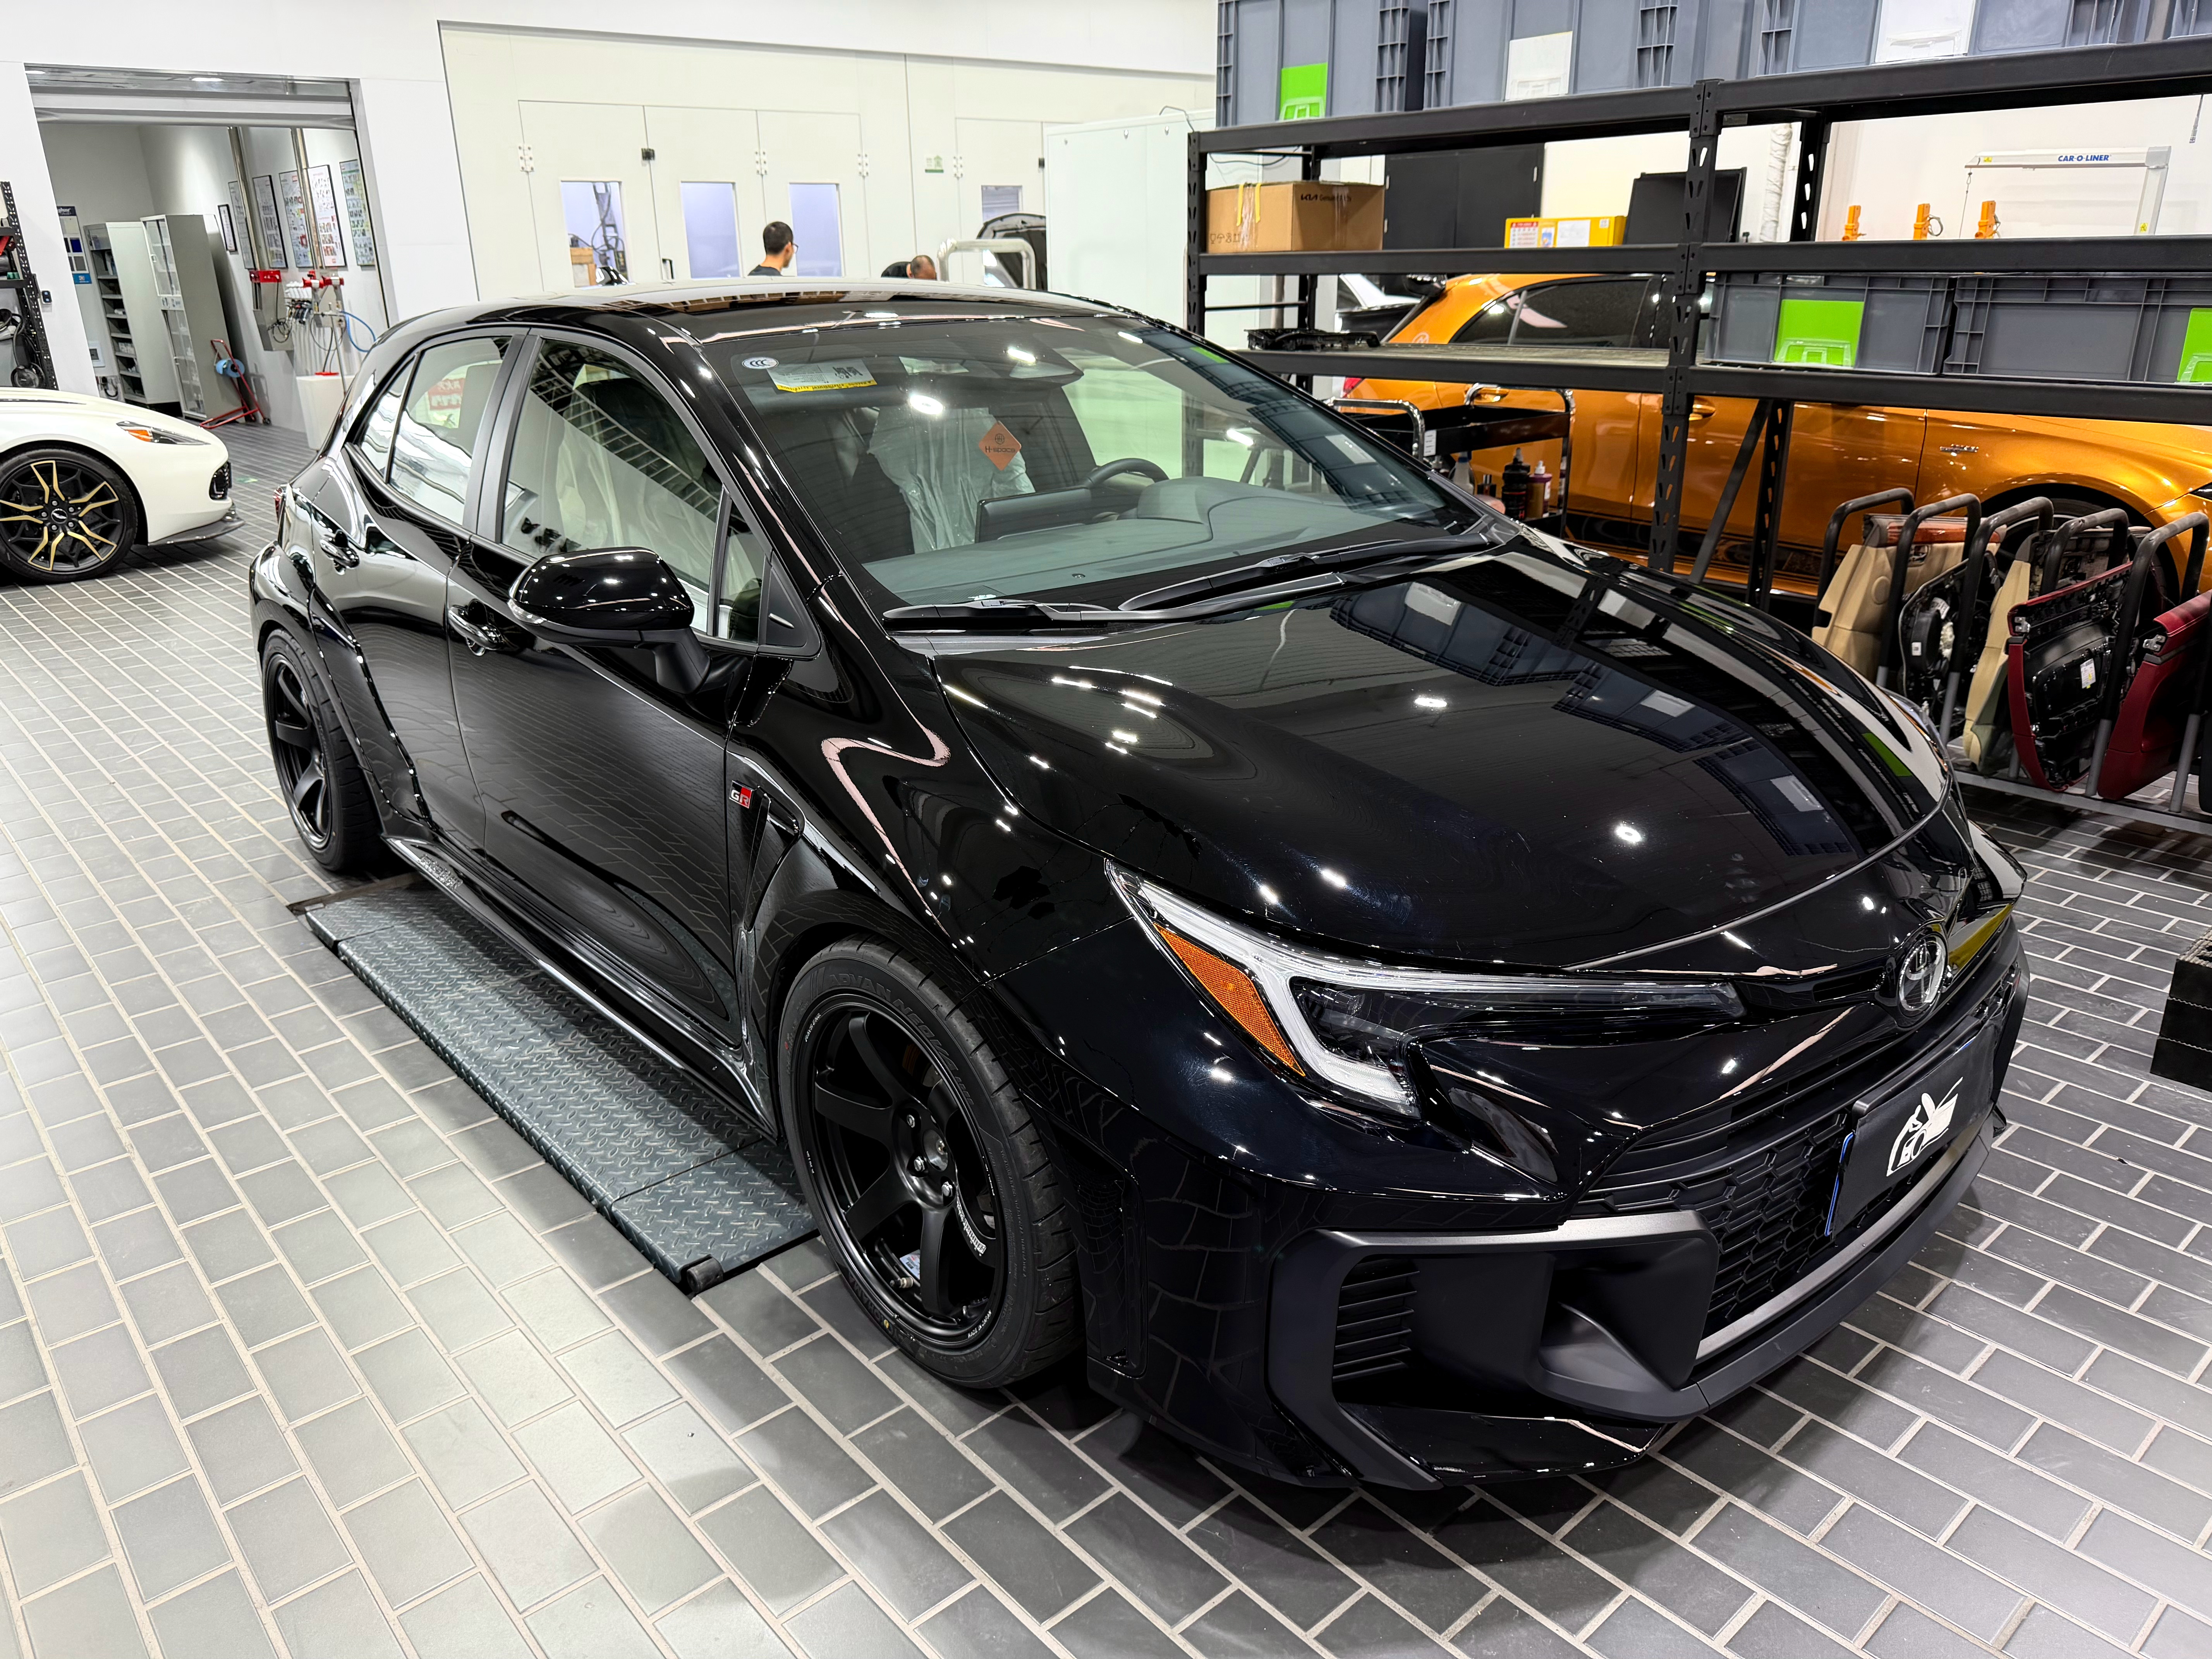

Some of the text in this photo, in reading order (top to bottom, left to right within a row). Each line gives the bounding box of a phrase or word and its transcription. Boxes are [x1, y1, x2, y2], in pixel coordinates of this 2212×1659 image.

[731, 789, 750, 806] GR
[829, 973, 959, 1071] ADVAN NEOVA
